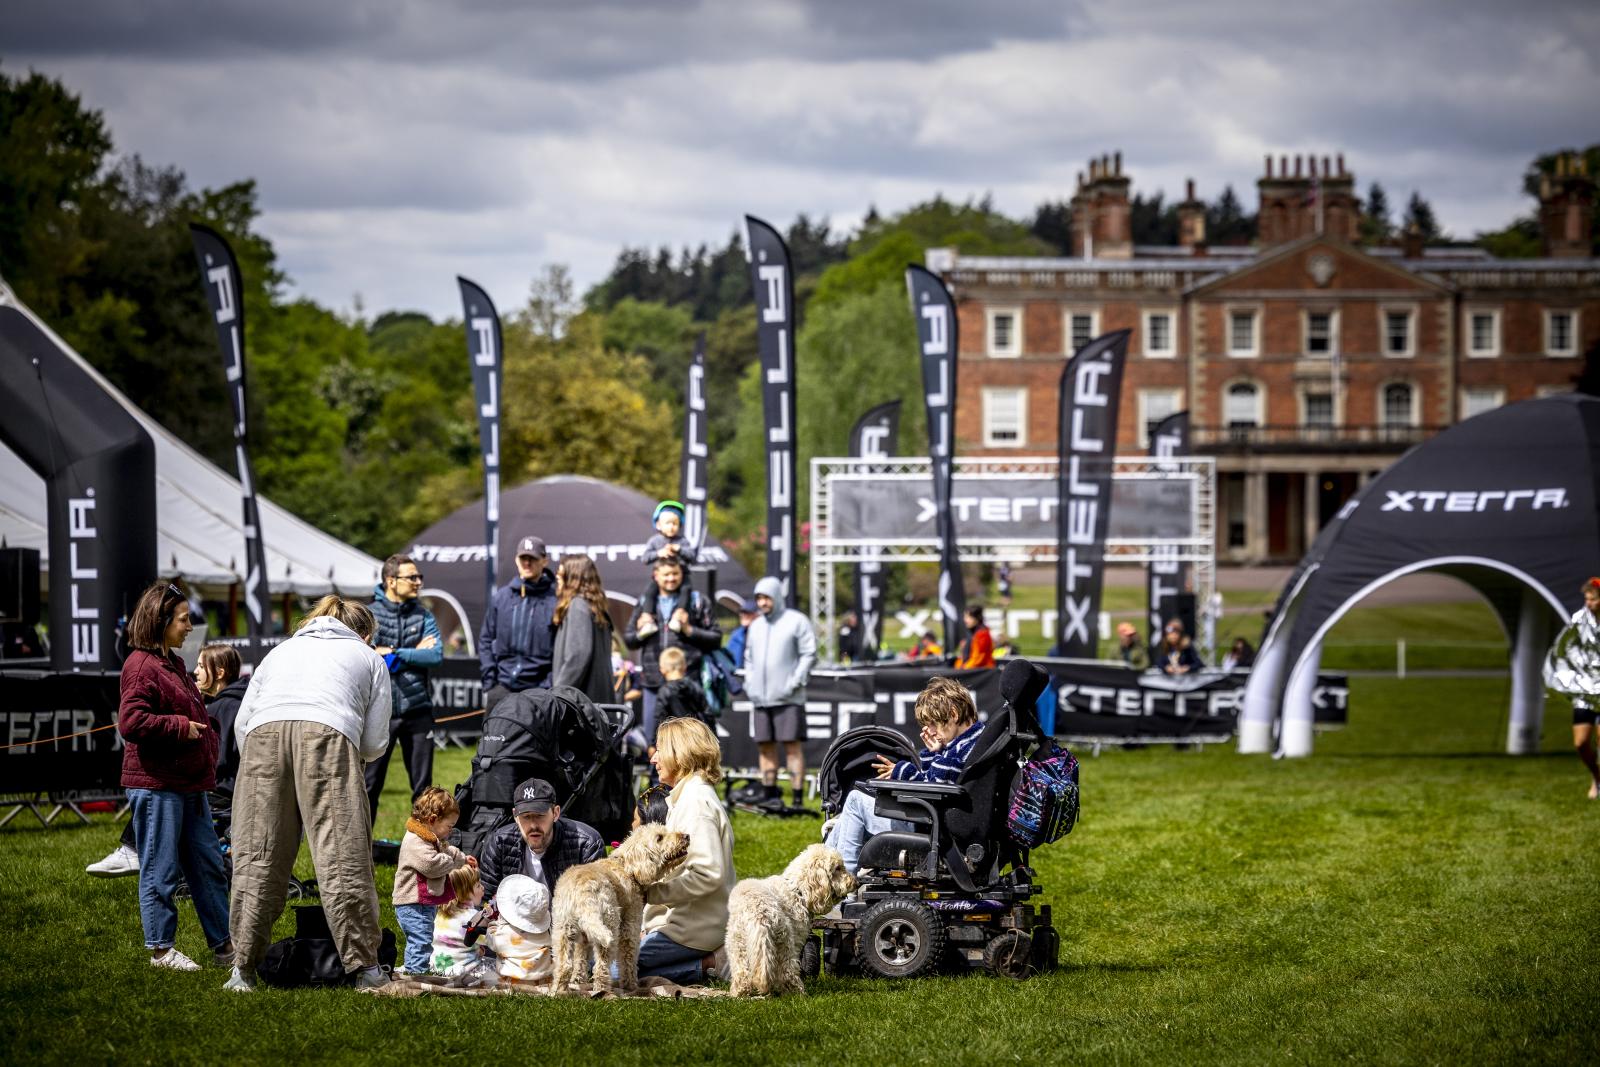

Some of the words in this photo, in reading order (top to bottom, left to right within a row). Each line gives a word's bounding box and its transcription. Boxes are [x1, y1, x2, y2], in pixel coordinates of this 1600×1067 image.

[916, 496, 1059, 522] XTERR
[1065, 360, 1112, 643] XTERRA
[1380, 488, 1568, 512] XTERRA
[69, 499, 100, 673] ERRA
[431, 680, 488, 708] XTERR
[523, 786, 535, 799] NY
[939, 900, 978, 910] Frontier
